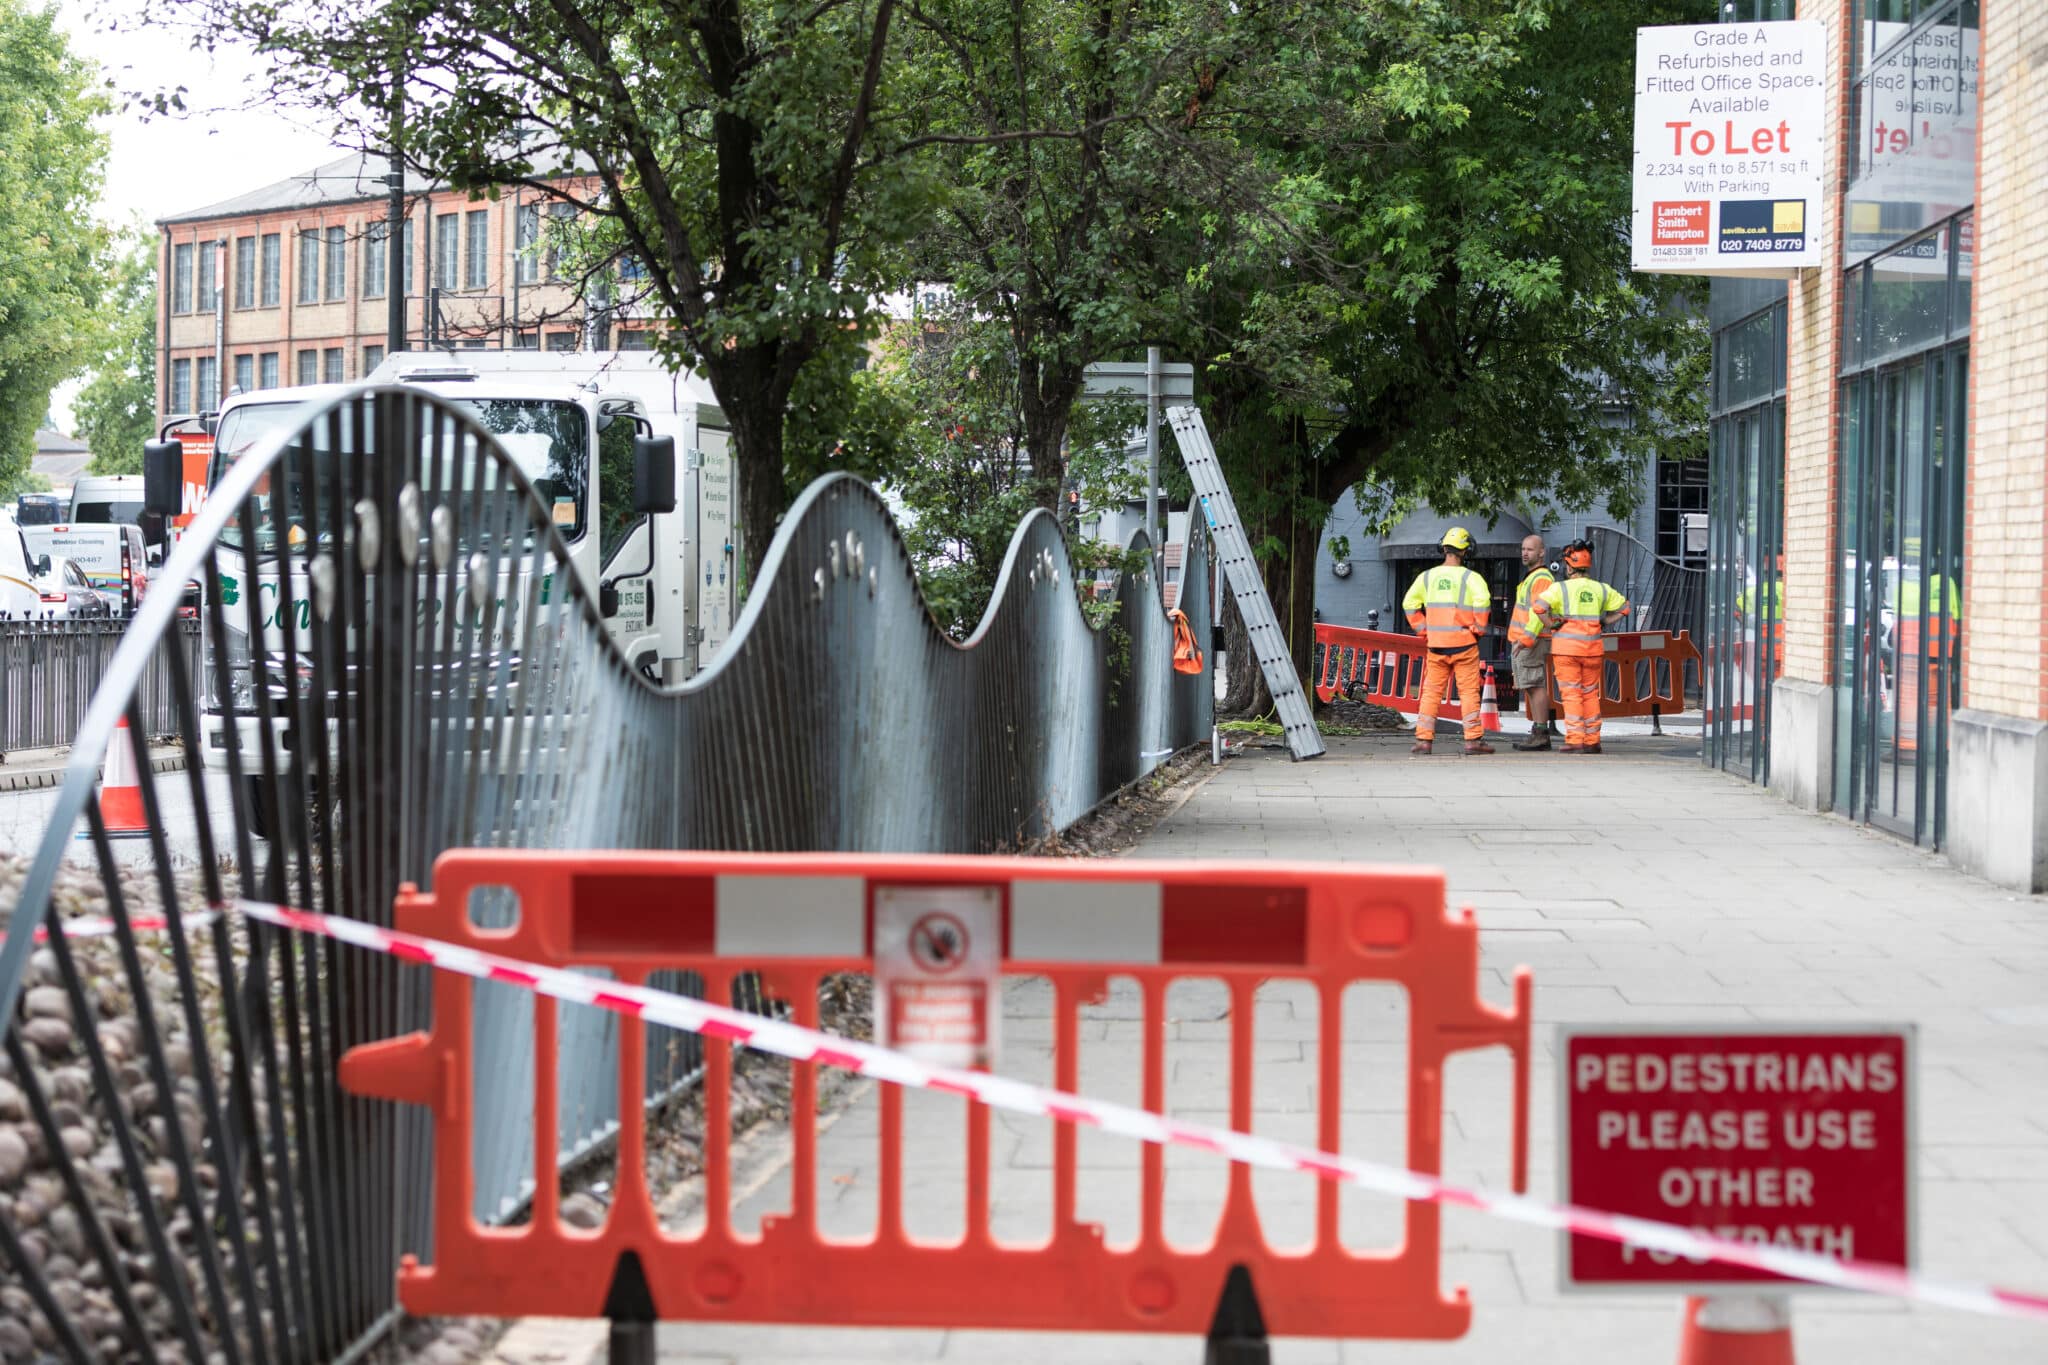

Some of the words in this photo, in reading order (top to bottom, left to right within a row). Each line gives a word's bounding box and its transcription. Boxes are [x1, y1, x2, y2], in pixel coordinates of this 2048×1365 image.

[1694, 29, 1748, 46] Grade
[1754, 28, 1767, 44] A
[1658, 51, 1764, 70] Refurbished
[1770, 50, 1803, 65] and
[1647, 76, 1695, 93] Fitted
[1701, 74, 1752, 91] Office
[1759, 72, 1814, 92] Space
[1689, 96, 1769, 114] Available
[1665, 121, 1715, 156] To
[1725, 120, 1790, 155] Let
[1688, 165, 1704, 179] sq
[1708, 163, 1717, 175] ft
[1721, 163, 1734, 174] to
[1780, 162, 1796, 176] sq
[1800, 160, 1809, 172] ft
[1684, 180, 1714, 193] With
[1719, 179, 1770, 194] Parking
[1657, 206, 1703, 217] Lambert
[1657, 217, 1688, 228] Smith
[1657, 228, 1705, 241] Hampton
[1652, 247, 1677, 256] 01483
[1678, 247, 1693, 256] 538
[1695, 247, 1708, 256] 181
[1720, 239, 1742, 251] 020
[1745, 239, 1772, 251] 7409
[1774, 238, 1803, 250] 8779
[1576, 1053, 1897, 1093] PEDESTRIANS
[1598, 1110, 1770, 1150] PLEASE
[1783, 1110, 1877, 1150] USE
[1659, 1168, 1815, 1207] OTHER
